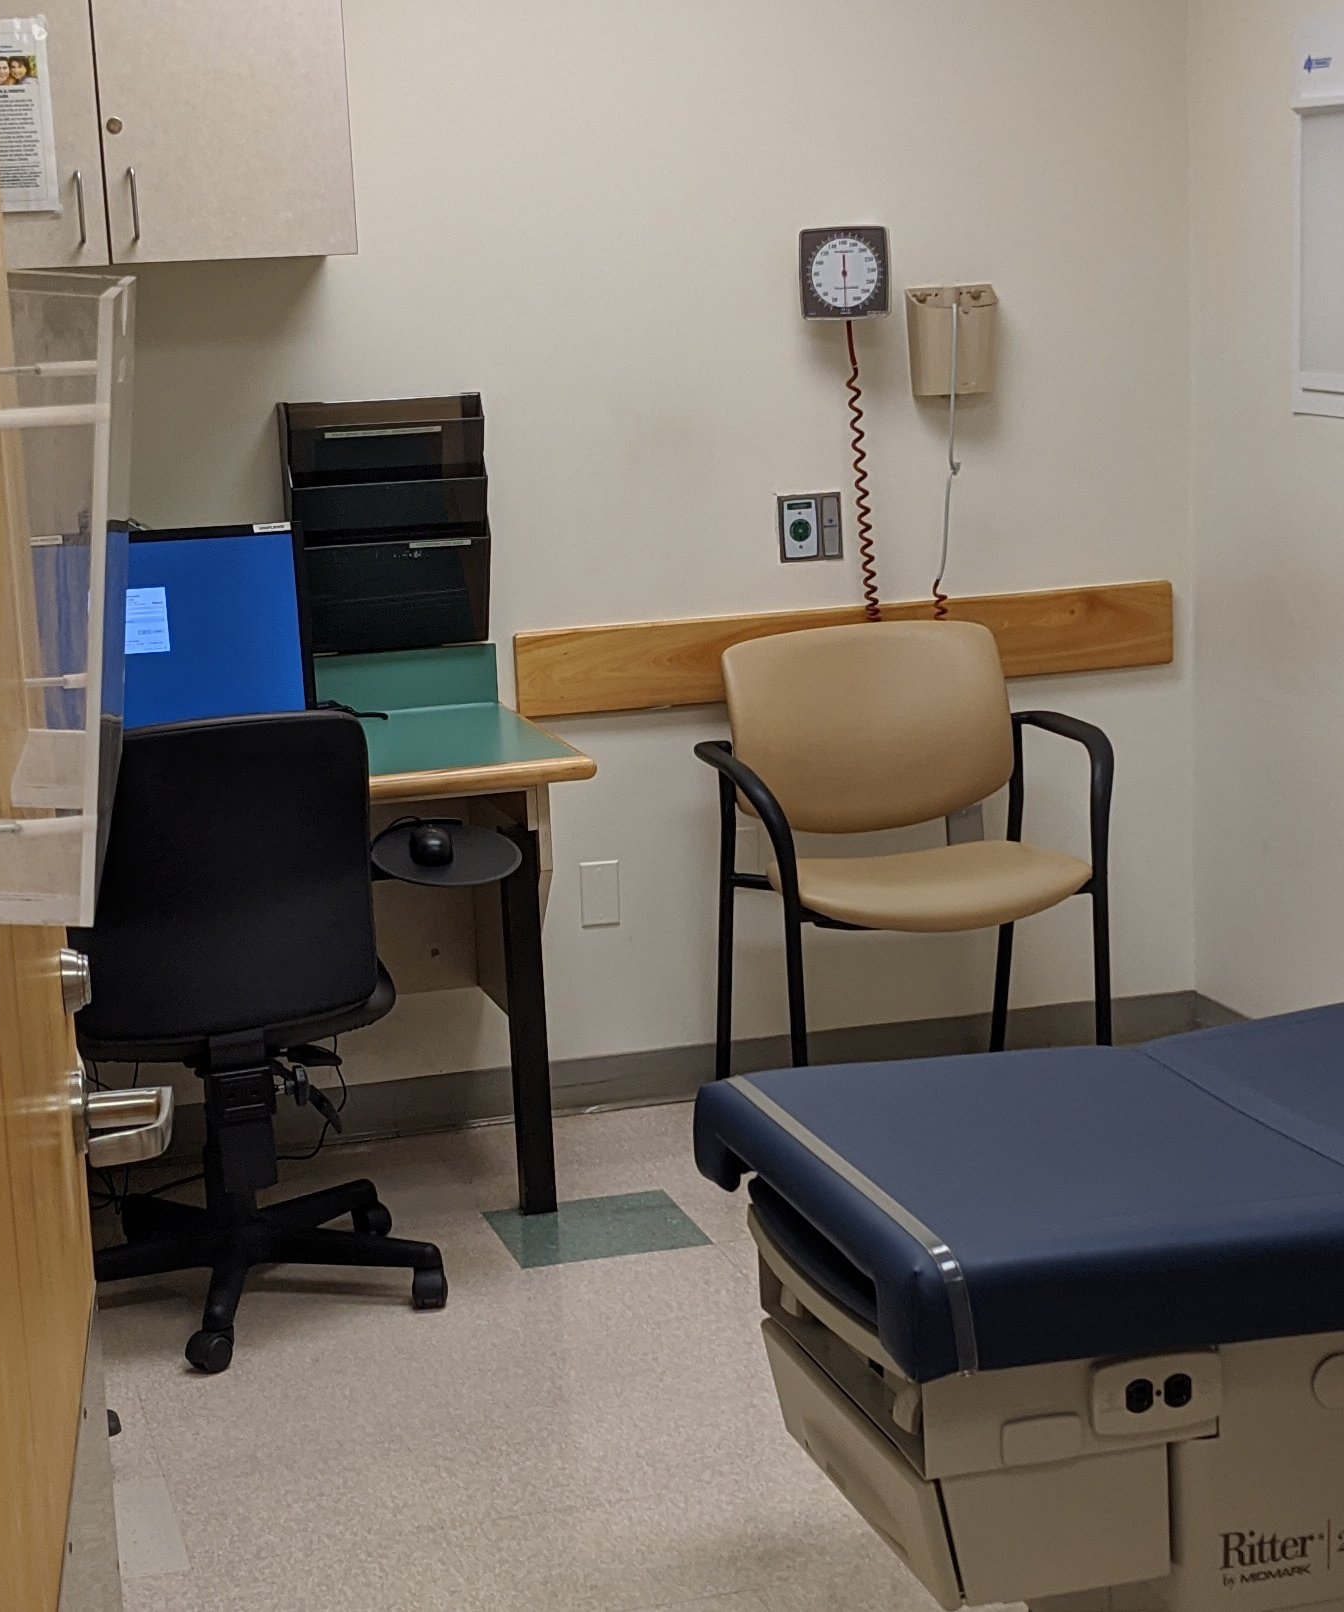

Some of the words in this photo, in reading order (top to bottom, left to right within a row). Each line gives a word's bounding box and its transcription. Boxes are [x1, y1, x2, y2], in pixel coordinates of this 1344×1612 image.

[1219, 1530, 1315, 1570] Ritter
[1222, 1574, 1235, 1590] by
[1239, 1564, 1312, 1584] MIDMARK
